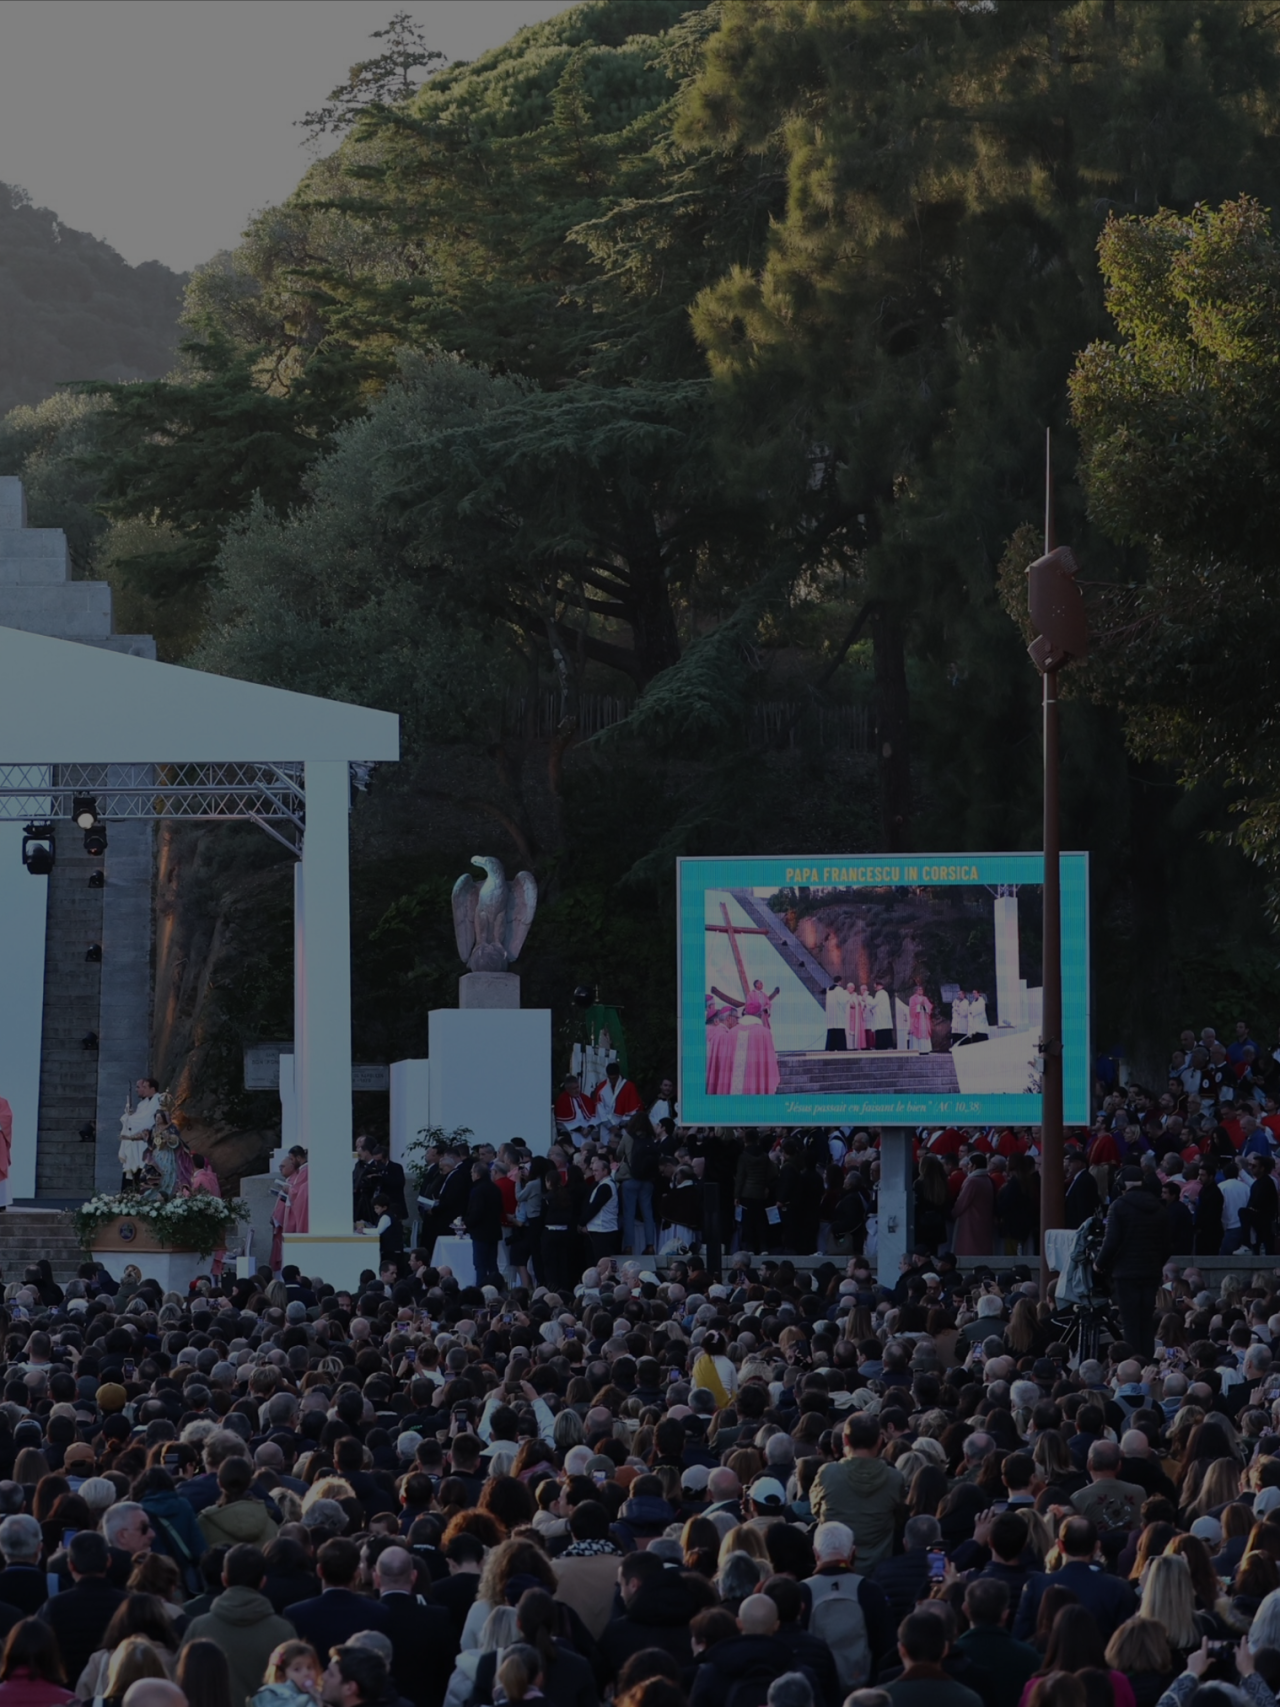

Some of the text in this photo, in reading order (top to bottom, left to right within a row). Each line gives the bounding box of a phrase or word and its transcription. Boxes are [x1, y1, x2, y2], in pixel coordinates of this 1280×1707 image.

[785, 865, 979, 882] PAPA FRANCESCU IN CORSICA
[812, 1102, 847, 1116] passait
[848, 1103, 860, 1112] en
[859, 1101, 894, 1115] faisant
[896, 1101, 905, 1112] le
[933, 1101, 952, 1113] (AC
